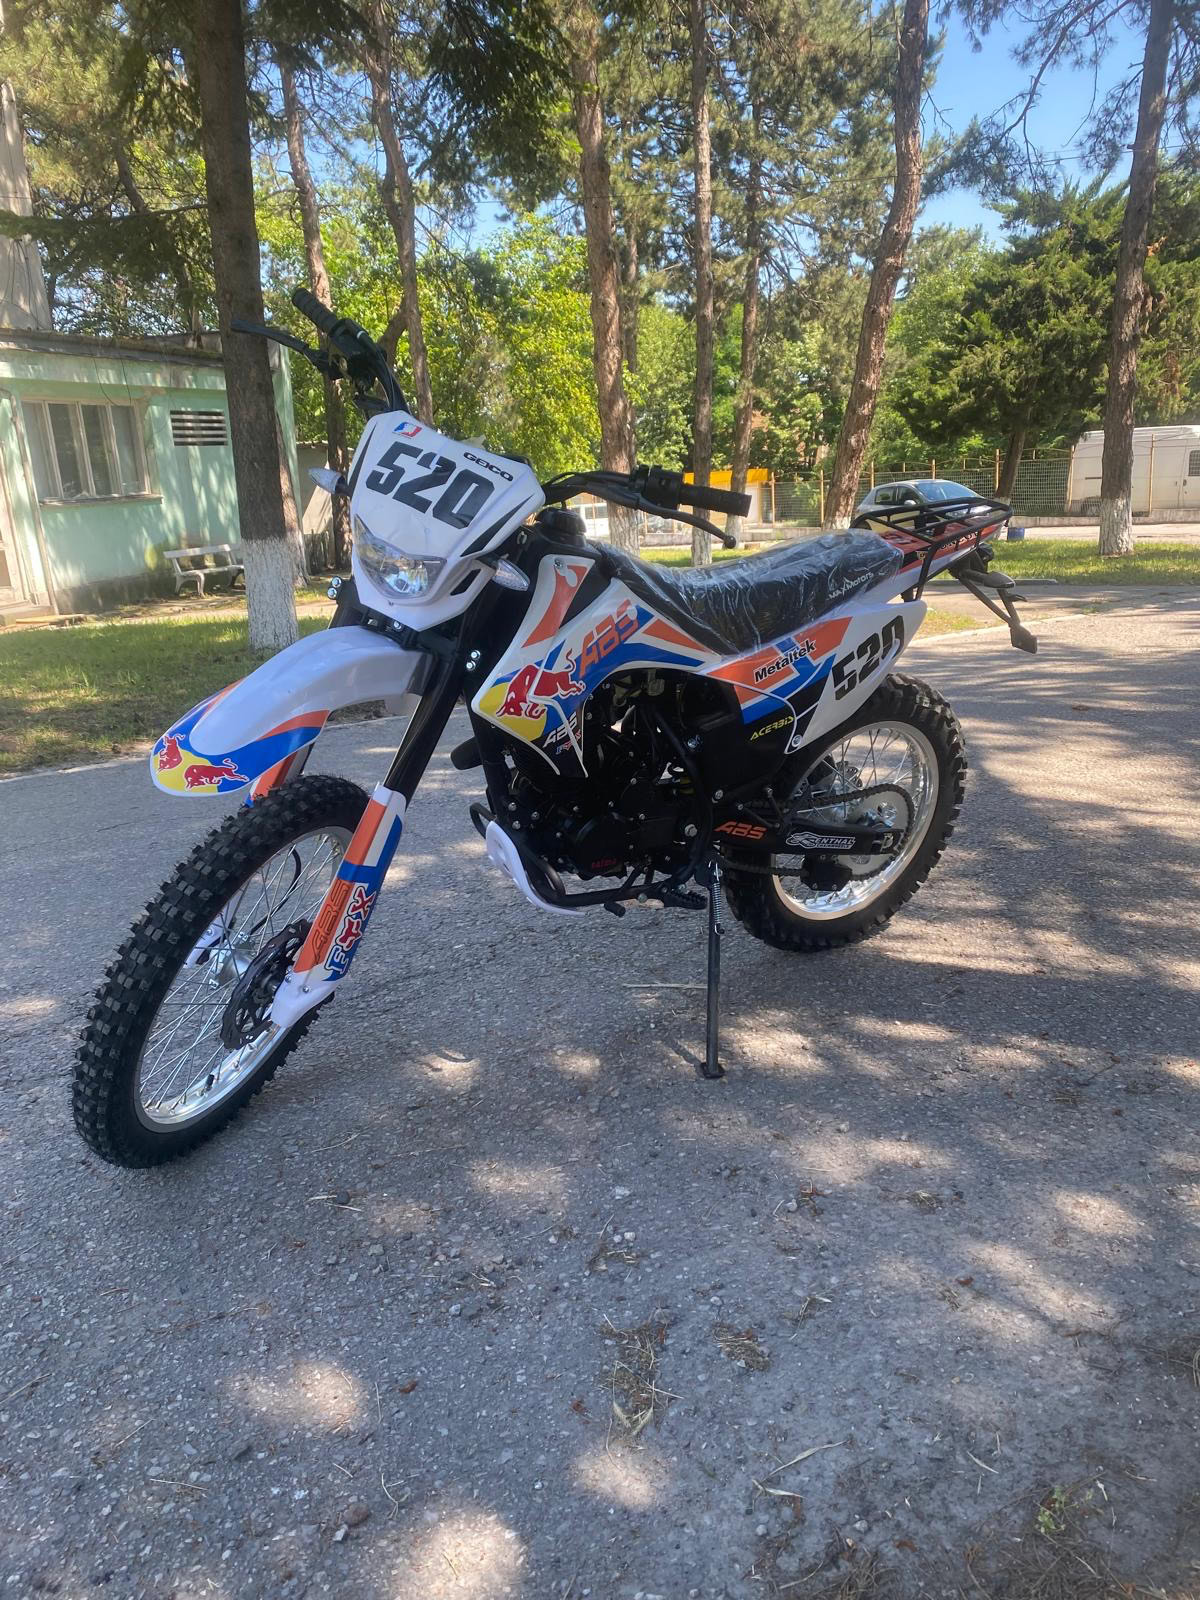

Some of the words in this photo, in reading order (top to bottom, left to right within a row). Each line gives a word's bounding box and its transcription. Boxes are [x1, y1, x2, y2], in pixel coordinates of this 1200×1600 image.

[365, 441, 495, 529] 520
[463, 452, 514, 481] GEICO
[579, 599, 640, 678] ABS
[754, 639, 816, 684] Metaltek
[831, 615, 905, 700] 520
[713, 821, 768, 840] ABS
[311, 877, 354, 968] ABS
